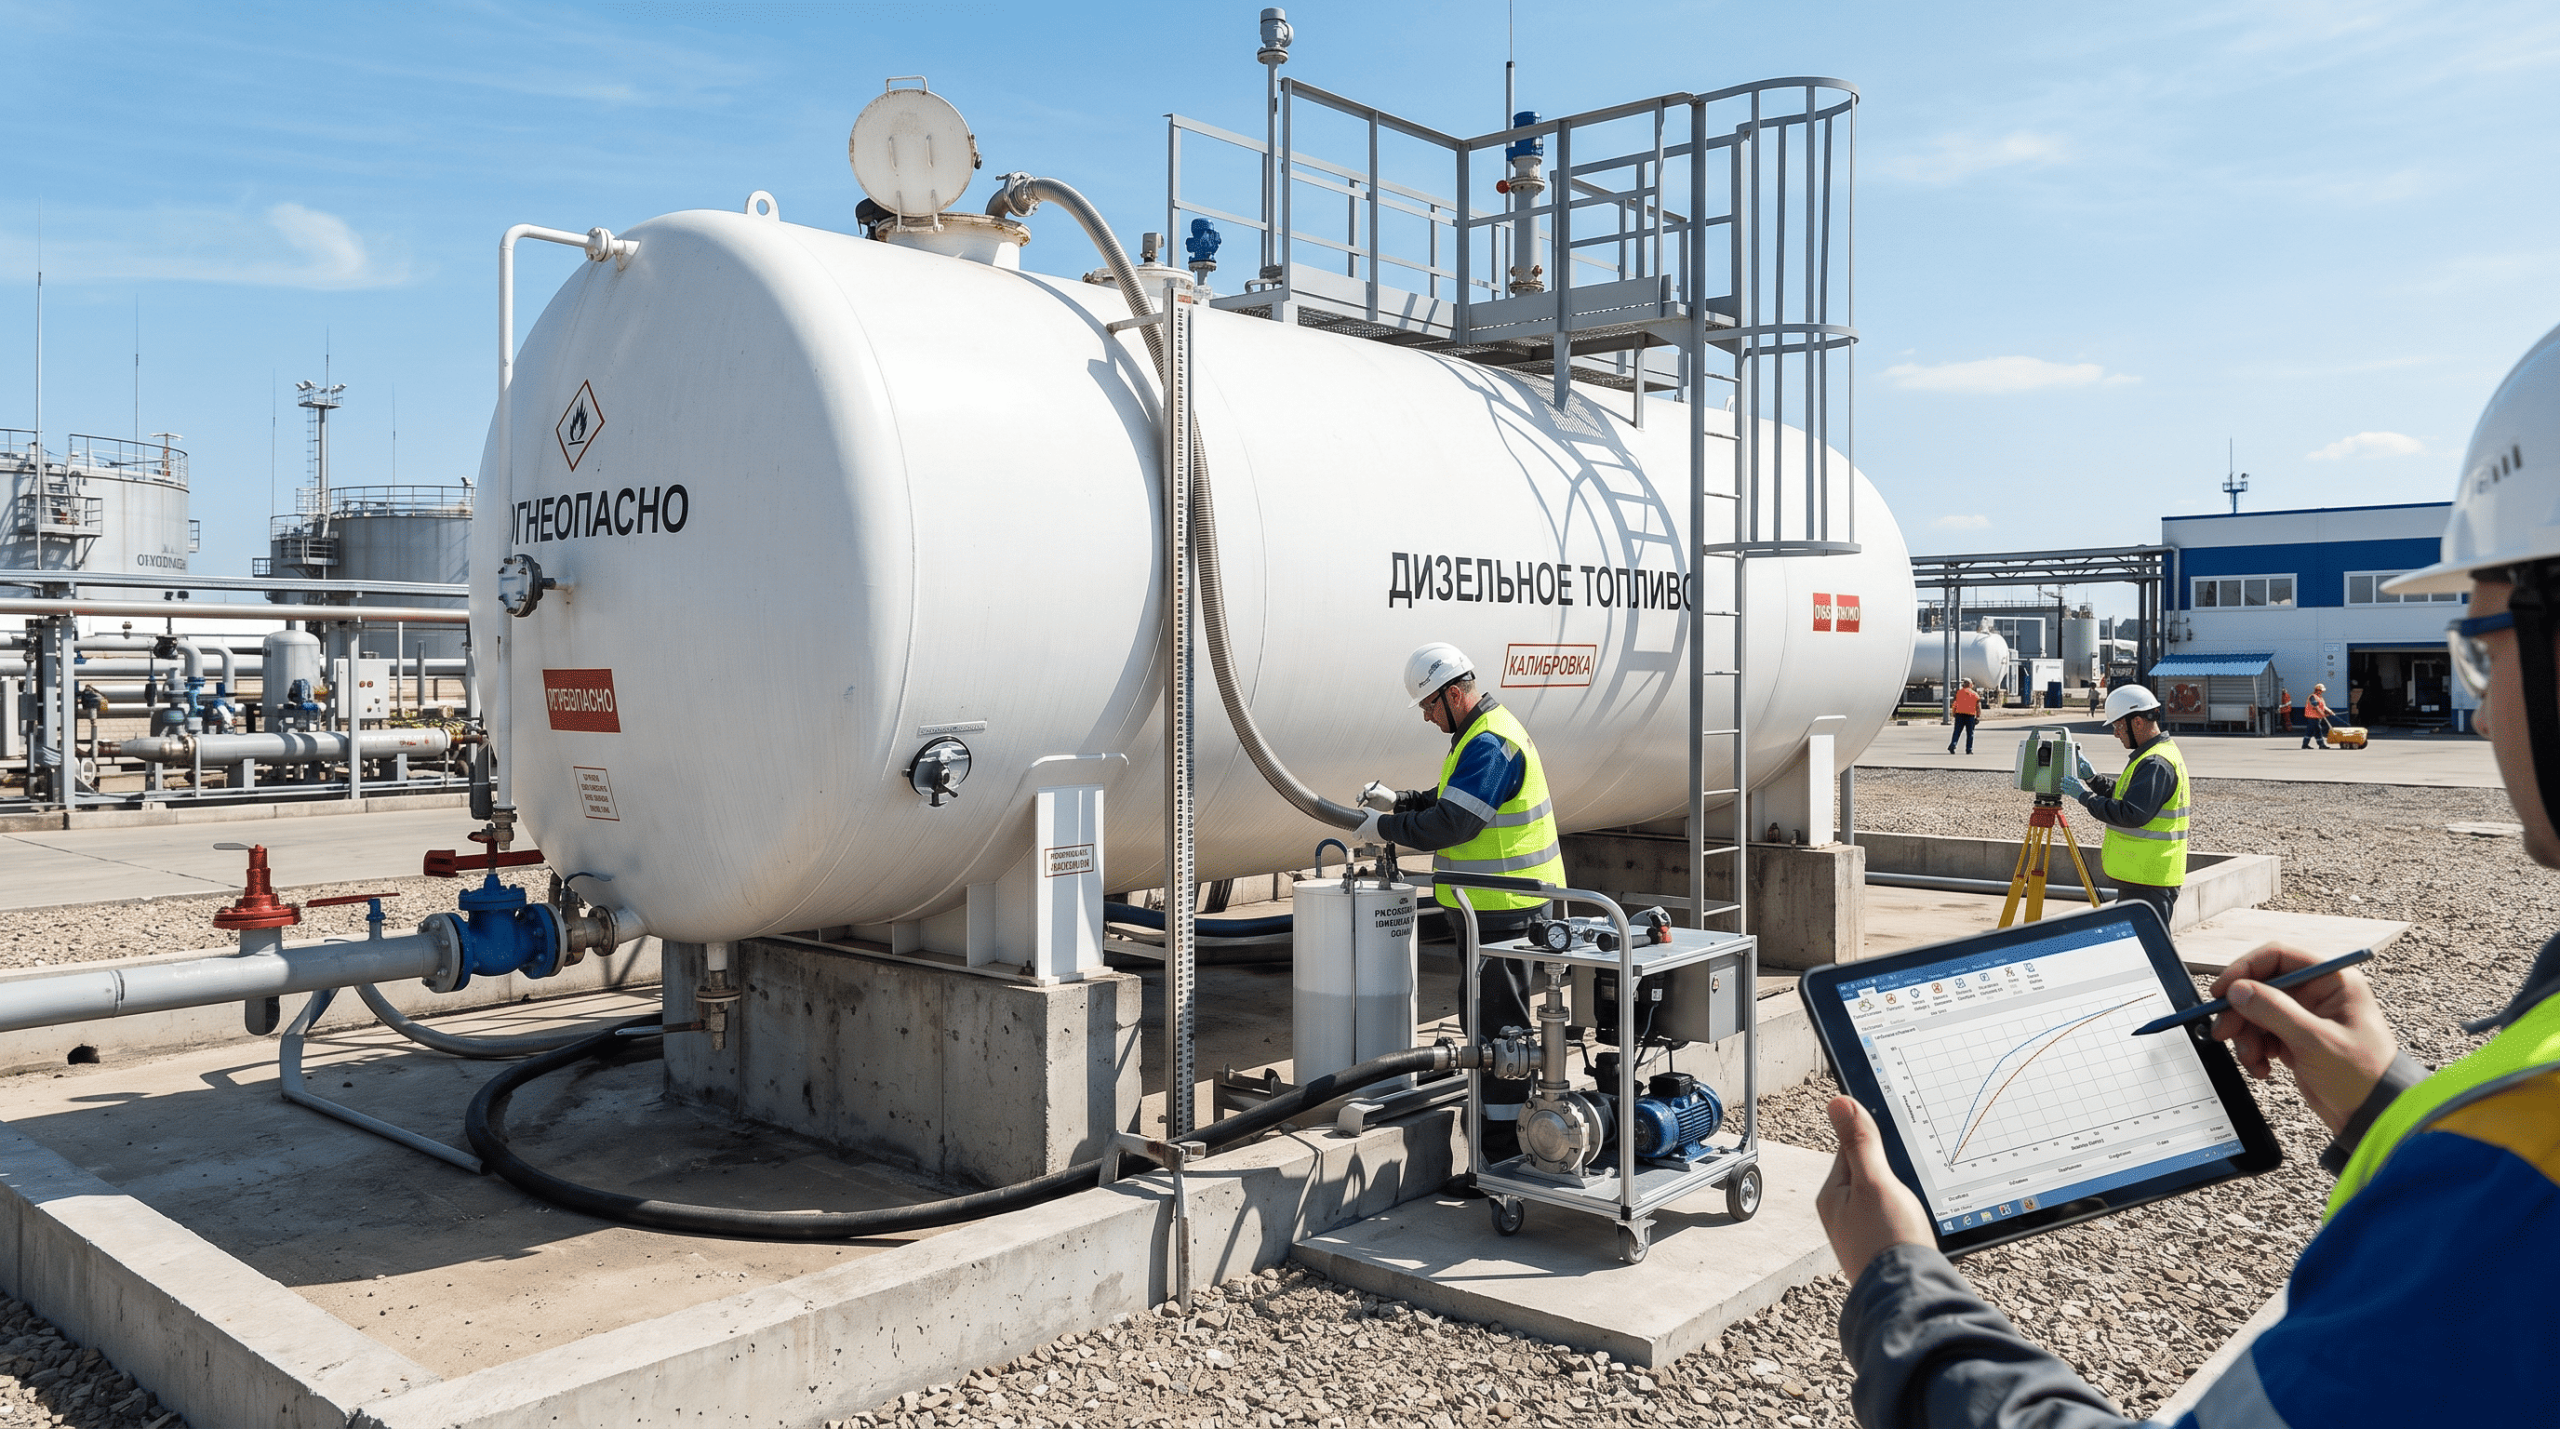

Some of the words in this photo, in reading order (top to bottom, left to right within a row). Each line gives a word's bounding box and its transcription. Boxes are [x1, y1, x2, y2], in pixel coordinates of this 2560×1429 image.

[511, 484, 689, 546] ГНЕОПАСНО
[1388, 551, 1574, 609] ДИЗЕЛЬНОЕ
[1508, 655, 1590, 676] КАЛИБРОВКА
